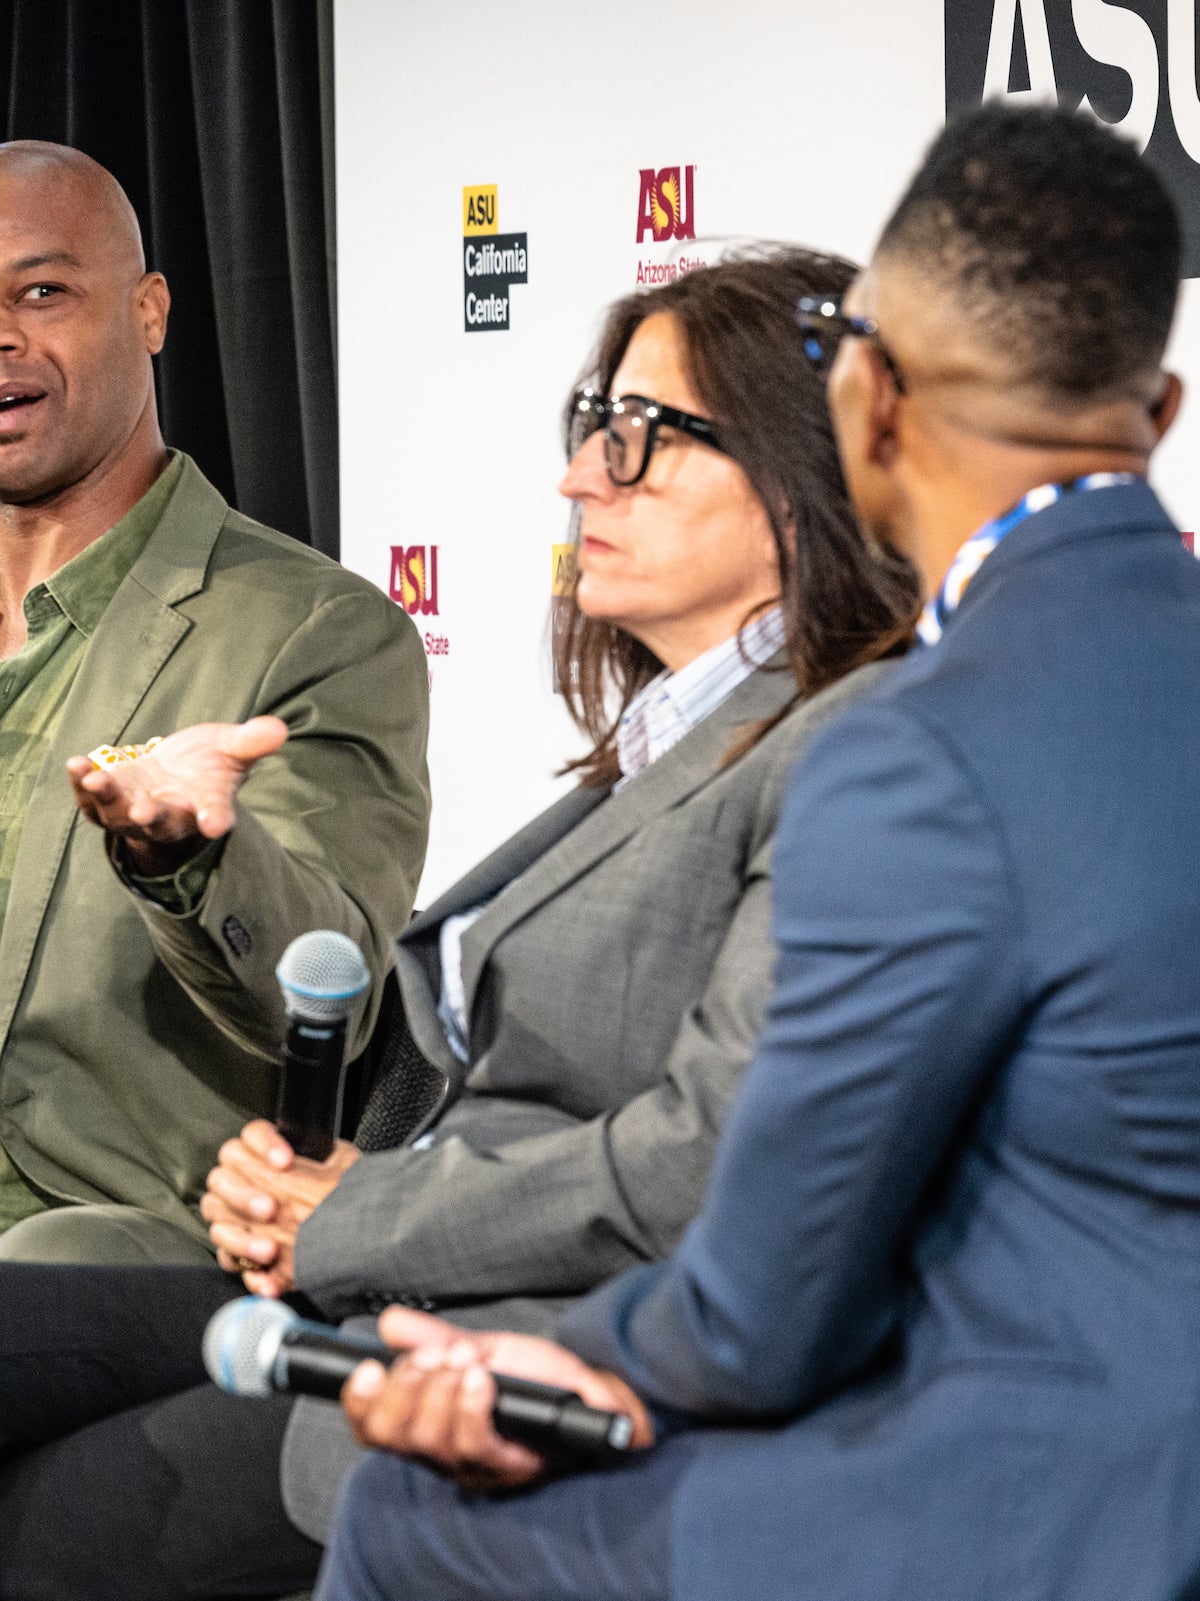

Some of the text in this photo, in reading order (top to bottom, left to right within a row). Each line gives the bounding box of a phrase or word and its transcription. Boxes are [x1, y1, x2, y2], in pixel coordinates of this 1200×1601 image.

[467, 195, 495, 226] ASU
[636, 165, 695, 243] ASU
[465, 242, 526, 277] California
[636, 259, 677, 284] Arizona
[466, 292, 508, 324] Center
[389, 545, 439, 615] ASU
[425, 632, 449, 655] State
